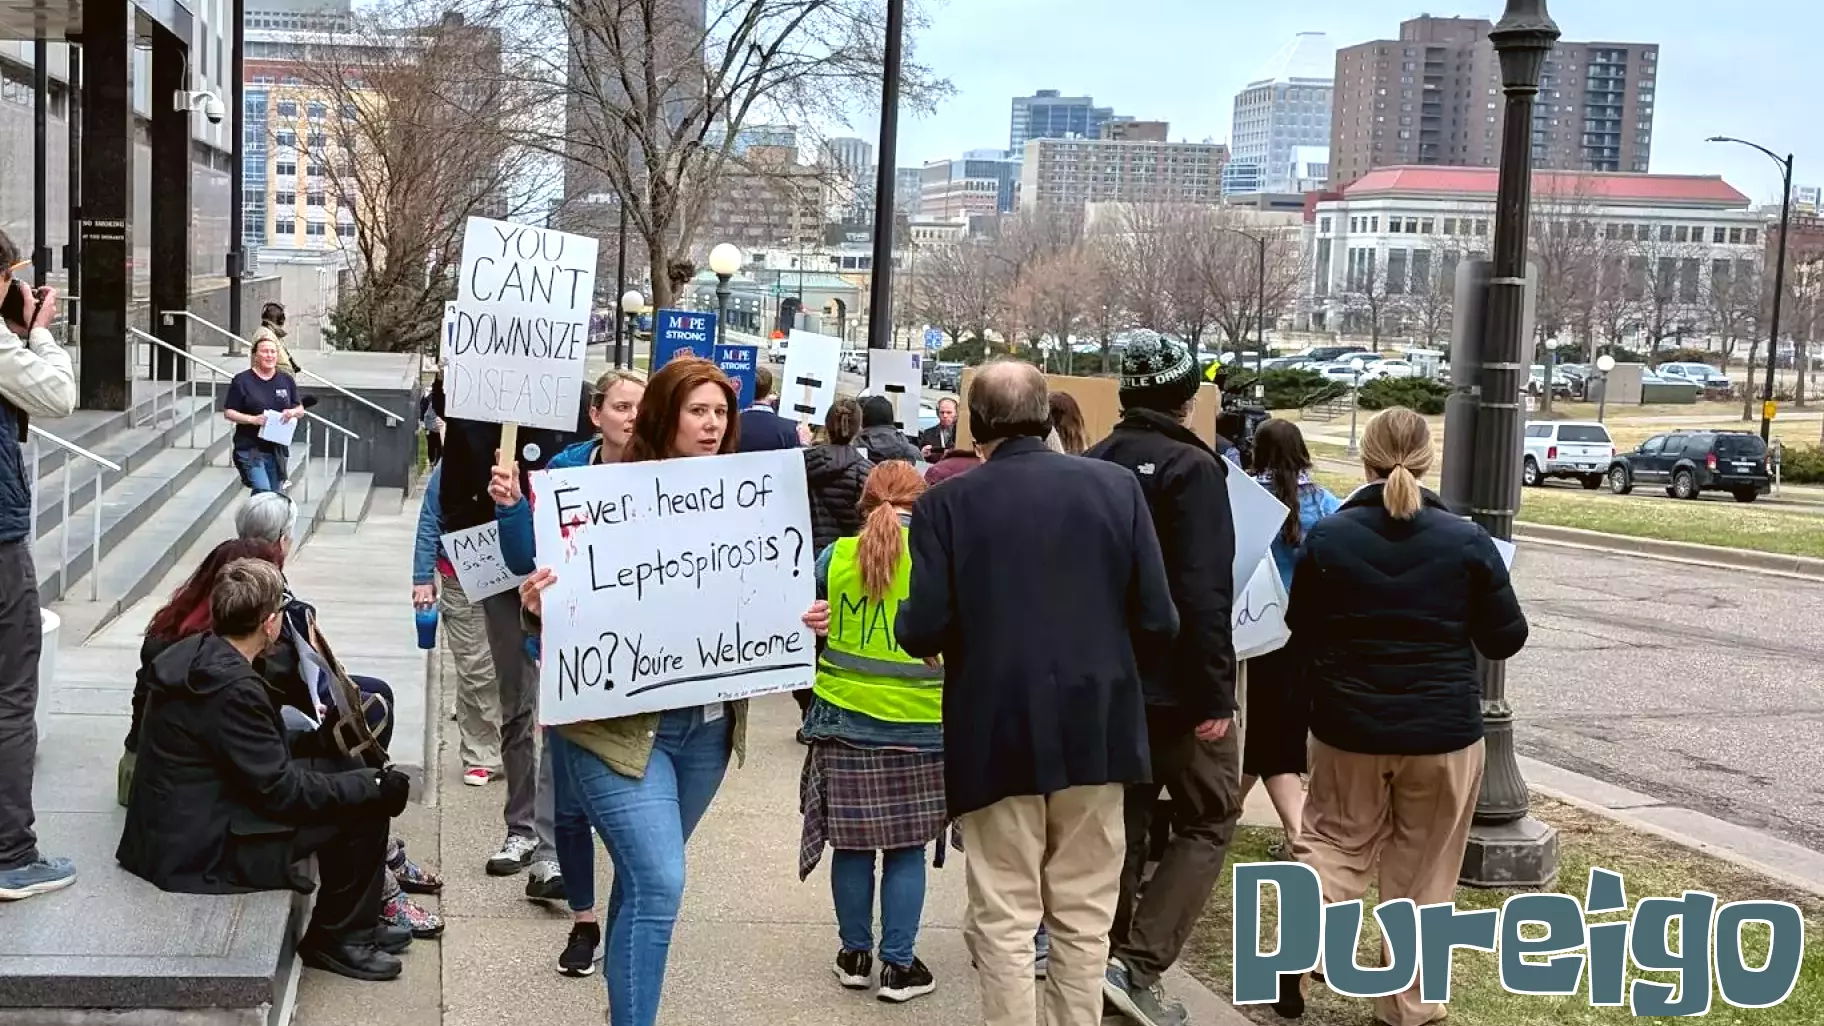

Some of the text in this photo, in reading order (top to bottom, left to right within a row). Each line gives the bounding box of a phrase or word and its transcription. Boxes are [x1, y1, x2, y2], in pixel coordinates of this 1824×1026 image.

[494, 225, 565, 262] YOU
[471, 256, 589, 310] CAN'T
[455, 311, 584, 360] DOWNSIZE
[665, 330, 707, 342] STRONG
[451, 363, 572, 418] DISEASE
[720, 361, 751, 371] STRONG
[655, 477, 725, 517] heard
[838, 592, 901, 653] MA
[557, 631, 620, 701] NO?
[696, 621, 804, 670] Welcome
